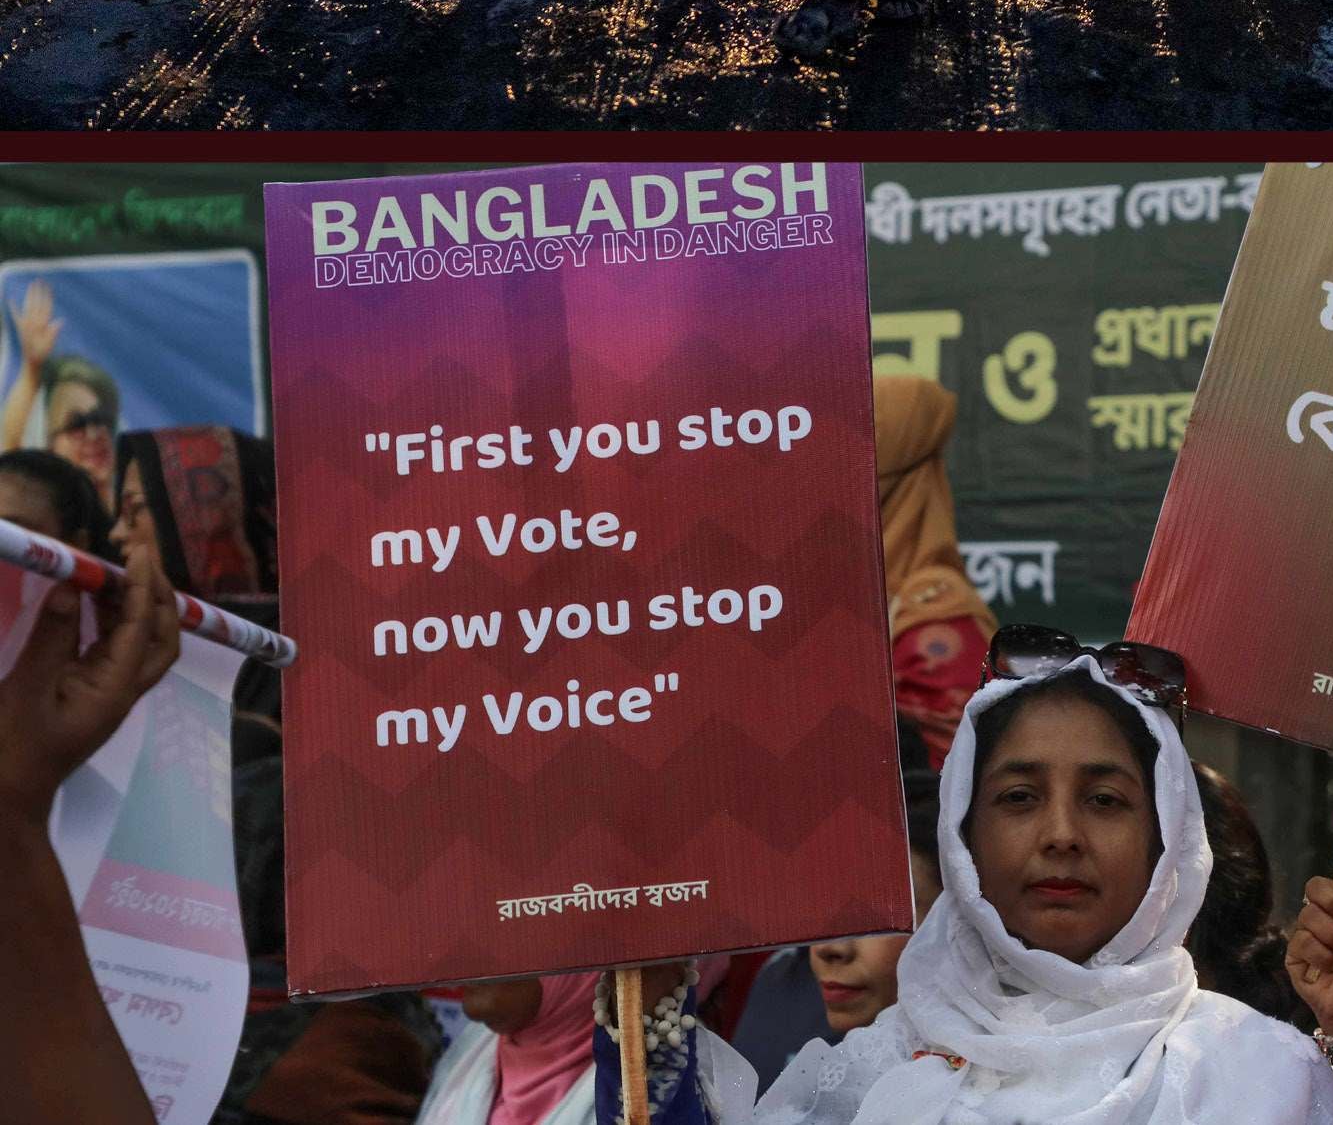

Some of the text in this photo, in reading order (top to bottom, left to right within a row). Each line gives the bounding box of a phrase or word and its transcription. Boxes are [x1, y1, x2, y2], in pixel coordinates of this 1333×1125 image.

[312, 162, 829, 256] BANGLADESH
[919, 183, 1124, 258] দলসমূহের
[314, 213, 833, 288] DEMOCRACY IN DANGER
[982, 329, 1058, 424] ও
[365, 405, 813, 475] "First you stop
[371, 508, 638, 573] my Vote,
[373, 584, 784, 657] now you stop
[376, 672, 680, 753] my Voice"
[496, 880, 710, 922] রাজবন্দীদের স্বজন
